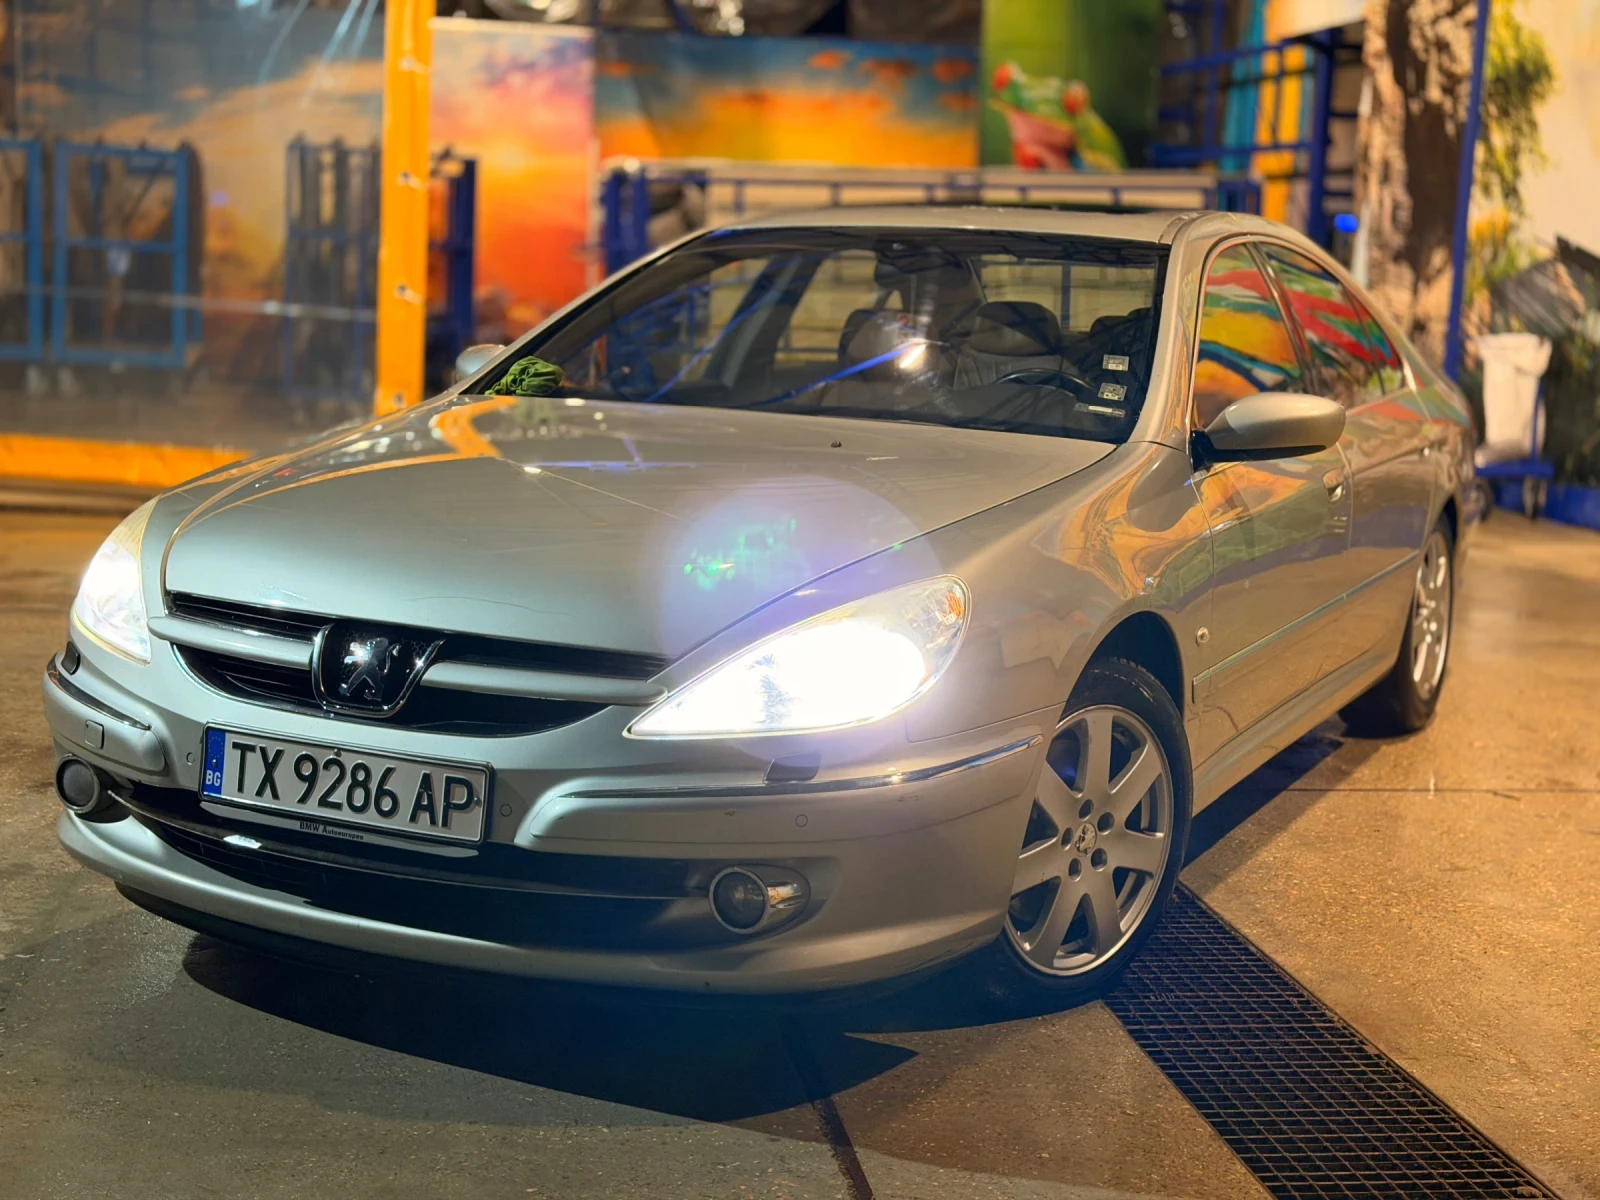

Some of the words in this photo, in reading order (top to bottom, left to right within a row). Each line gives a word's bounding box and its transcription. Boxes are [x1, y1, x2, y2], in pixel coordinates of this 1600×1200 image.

[205, 769, 221, 787] BG
[231, 741, 285, 800] TX
[293, 752, 400, 818] 9286
[408, 771, 475, 828] AP
[299, 821, 320, 832] BMW
